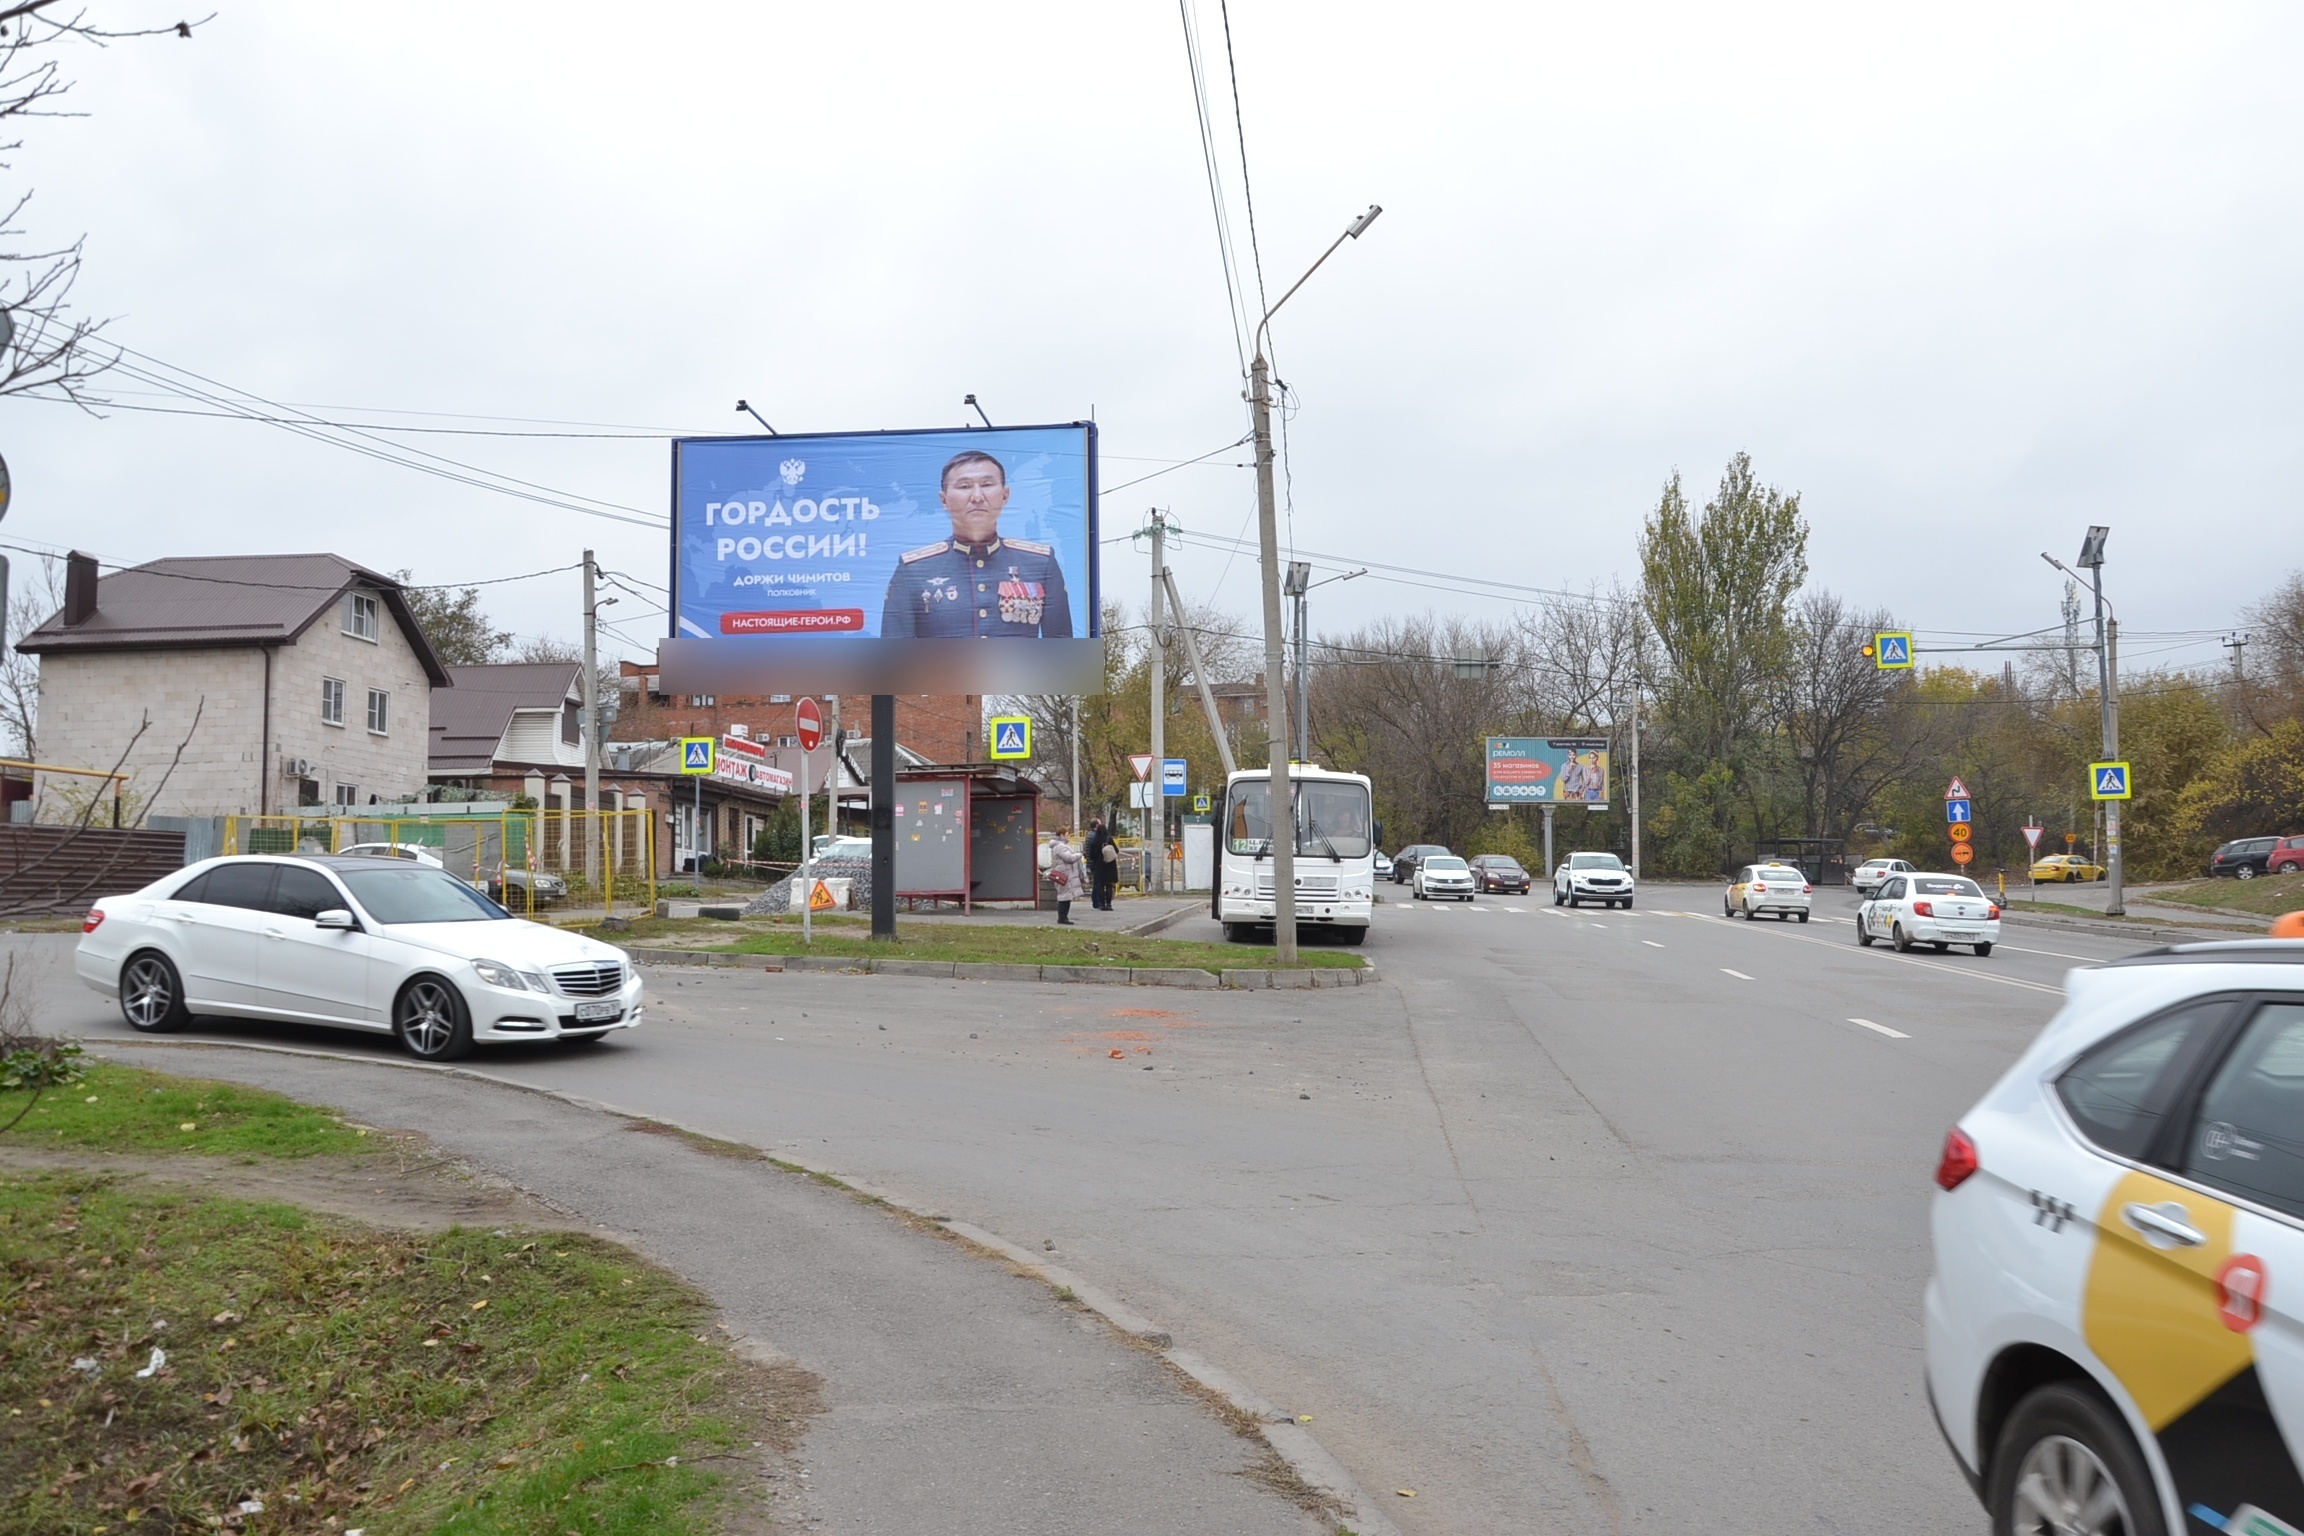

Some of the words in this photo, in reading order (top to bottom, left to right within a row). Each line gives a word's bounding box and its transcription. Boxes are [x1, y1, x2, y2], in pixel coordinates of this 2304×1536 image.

[706, 497, 880, 527] ГОРДОСТЬ
[717, 532, 867, 561] РОССИИ!
[733, 573, 784, 587] ДОРЖИ
[787, 571, 851, 584] ЧИМИТОВ
[732, 615, 852, 629] НАСТОЯЩИЕ-ГЕРОИ.РФ
[756, 770, 793, 786] АВТОМАГАЗИН
[1953, 828, 1967, 837] 40
[1234, 840, 1246, 851] 12
